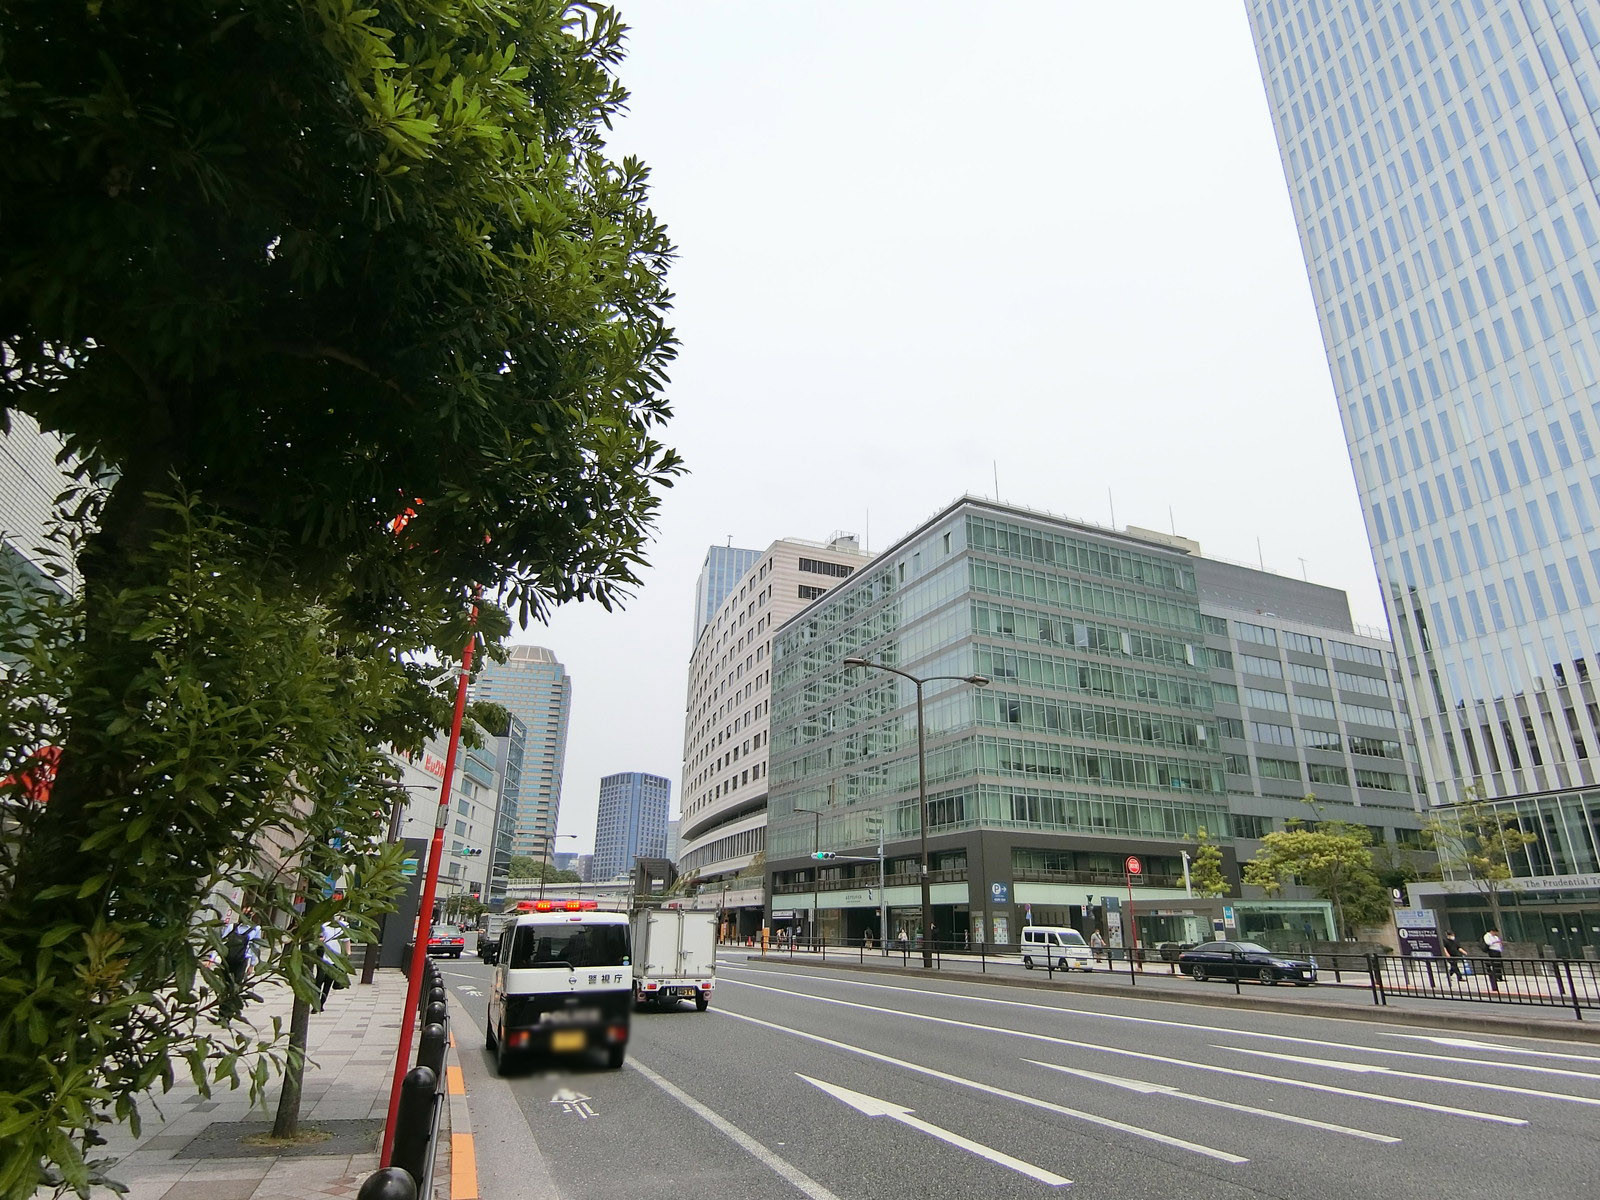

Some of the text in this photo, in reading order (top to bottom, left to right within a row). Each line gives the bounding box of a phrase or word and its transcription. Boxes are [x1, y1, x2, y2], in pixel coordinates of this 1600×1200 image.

[1523, 879, 1540, 888] The
[1543, 878, 1589, 887] Prudential
[588, 974, 622, 984] 警視庁
